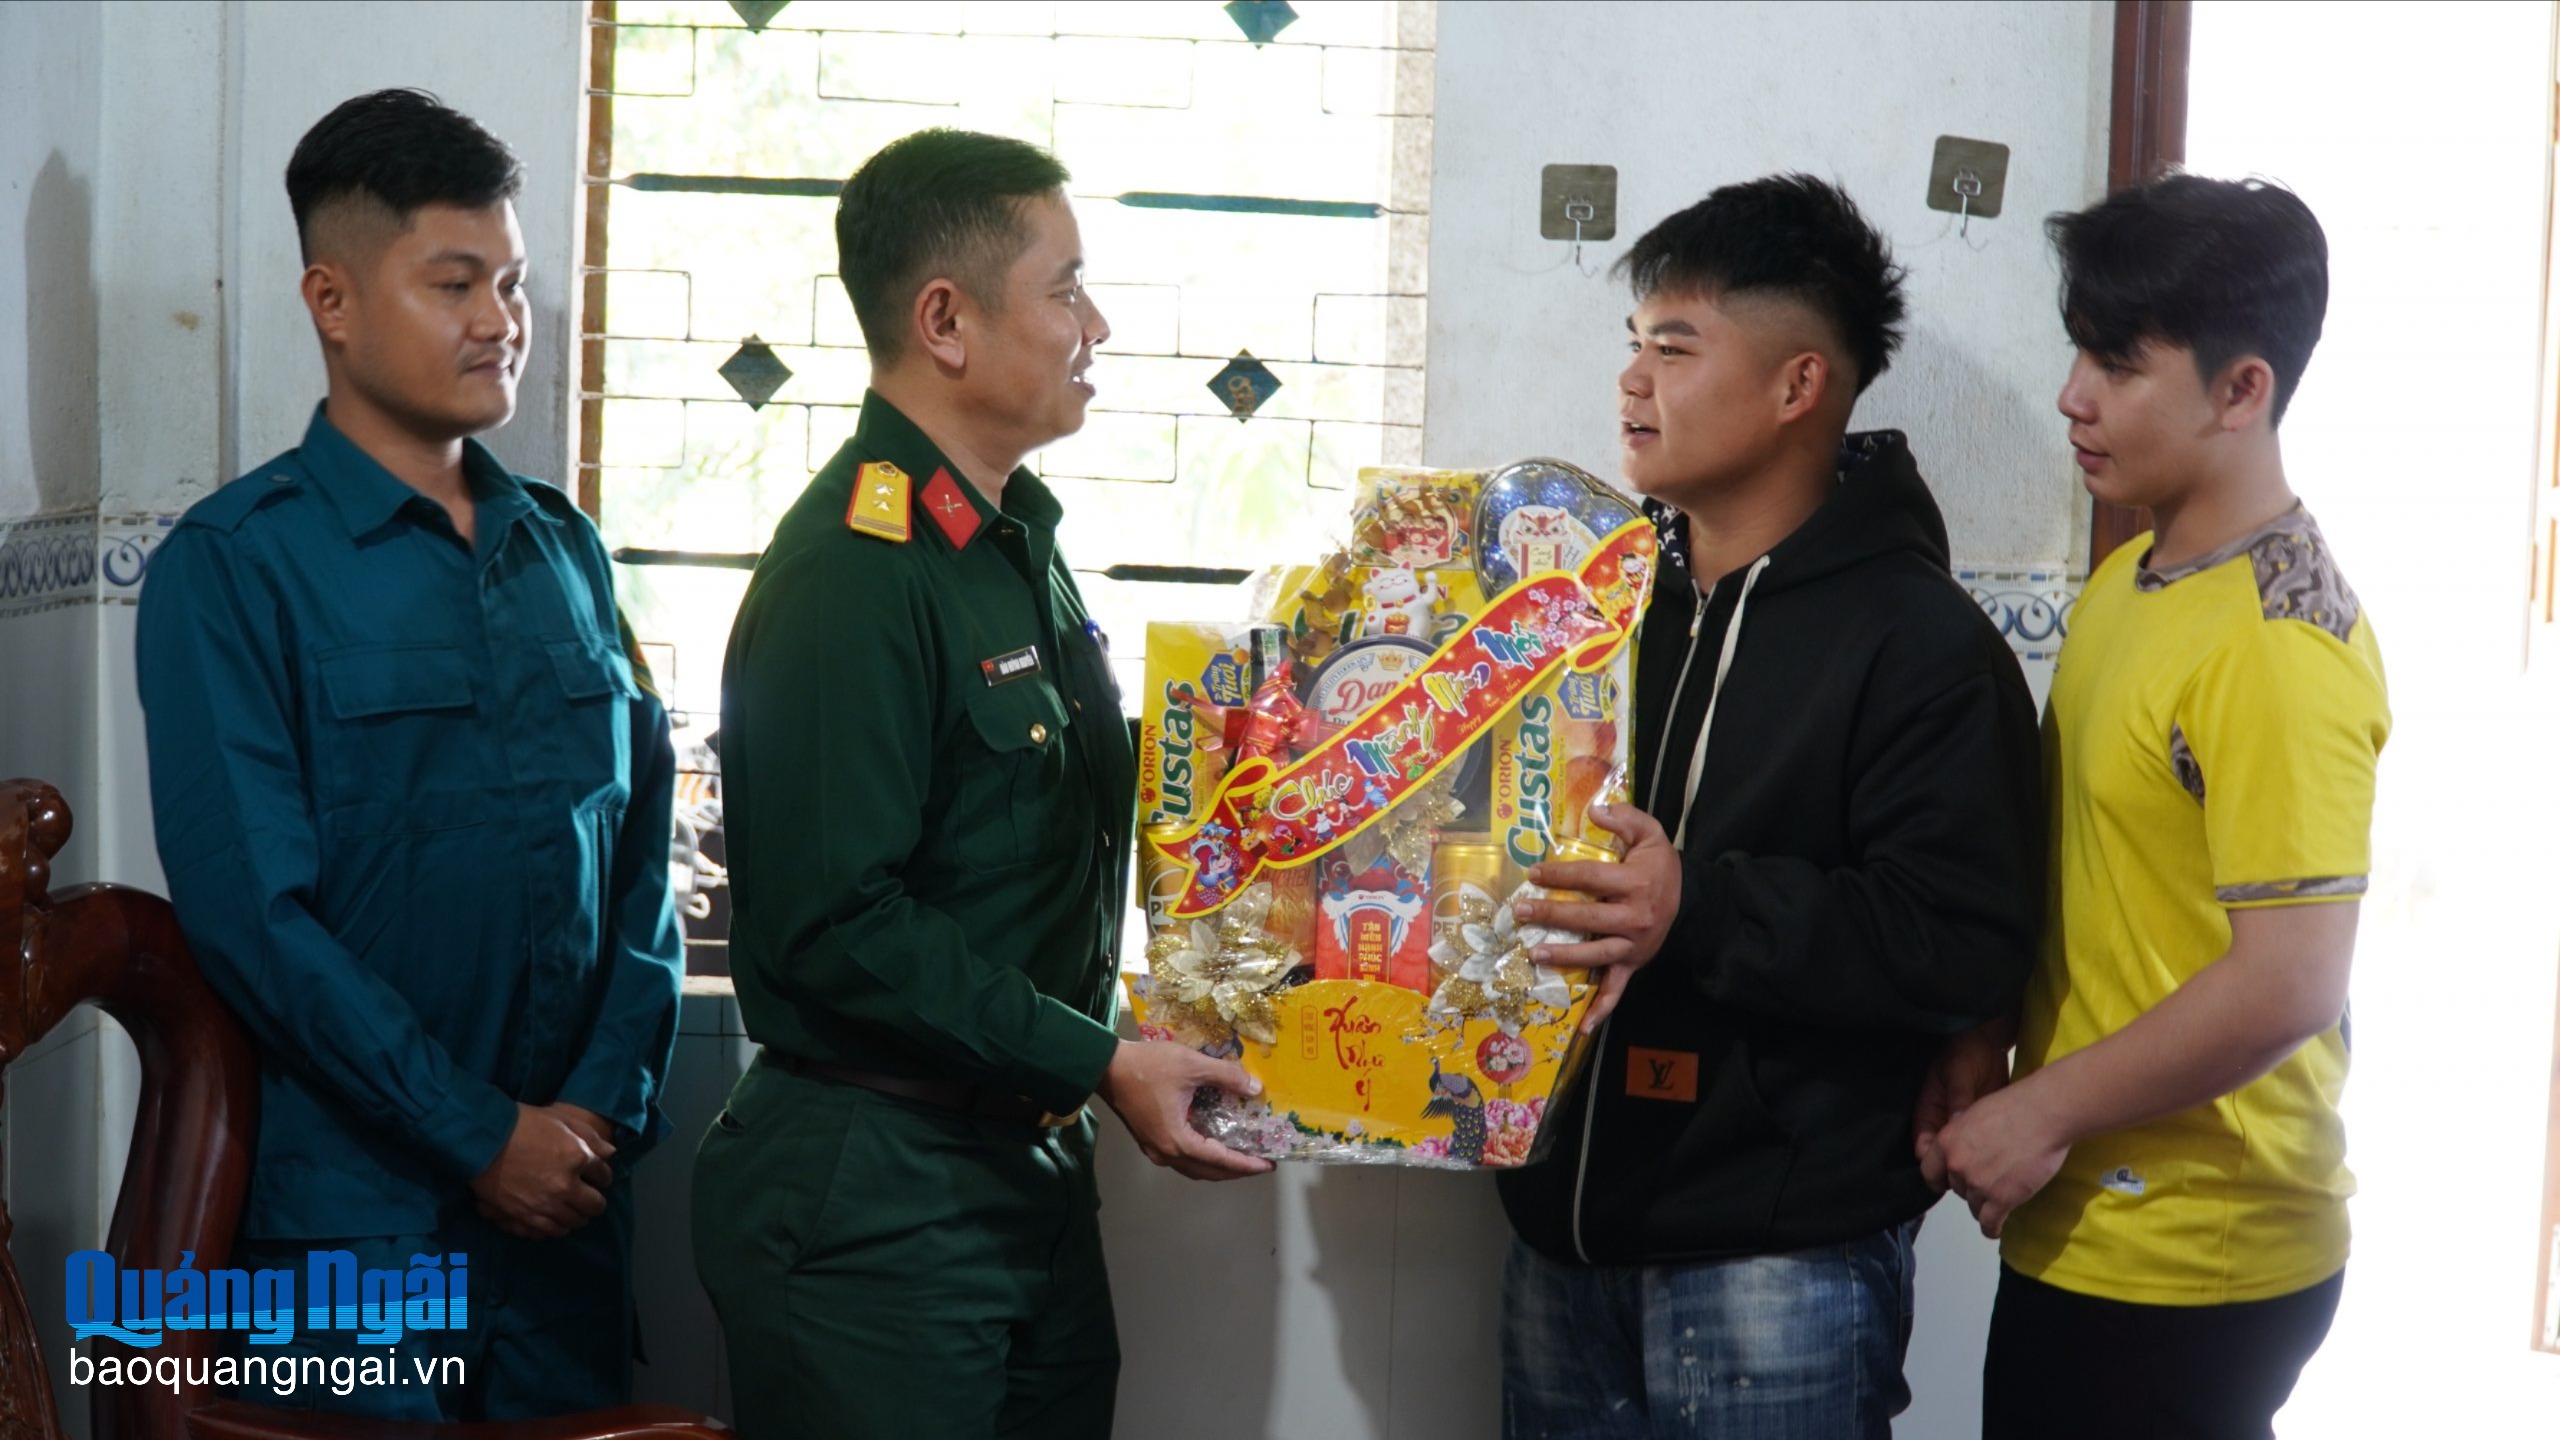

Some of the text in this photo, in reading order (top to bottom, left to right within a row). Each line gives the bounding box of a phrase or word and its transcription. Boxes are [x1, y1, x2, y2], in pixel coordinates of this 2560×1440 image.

[1143, 724, 1157, 784] ORION
[1151, 679, 1195, 823] ustas
[1270, 769, 1353, 821] Chúc
[1421, 661, 1491, 717] Năm
[1472, 620, 1546, 671] Mới
[1498, 739, 1512, 798] ORION
[1506, 694, 1554, 870] Custas
